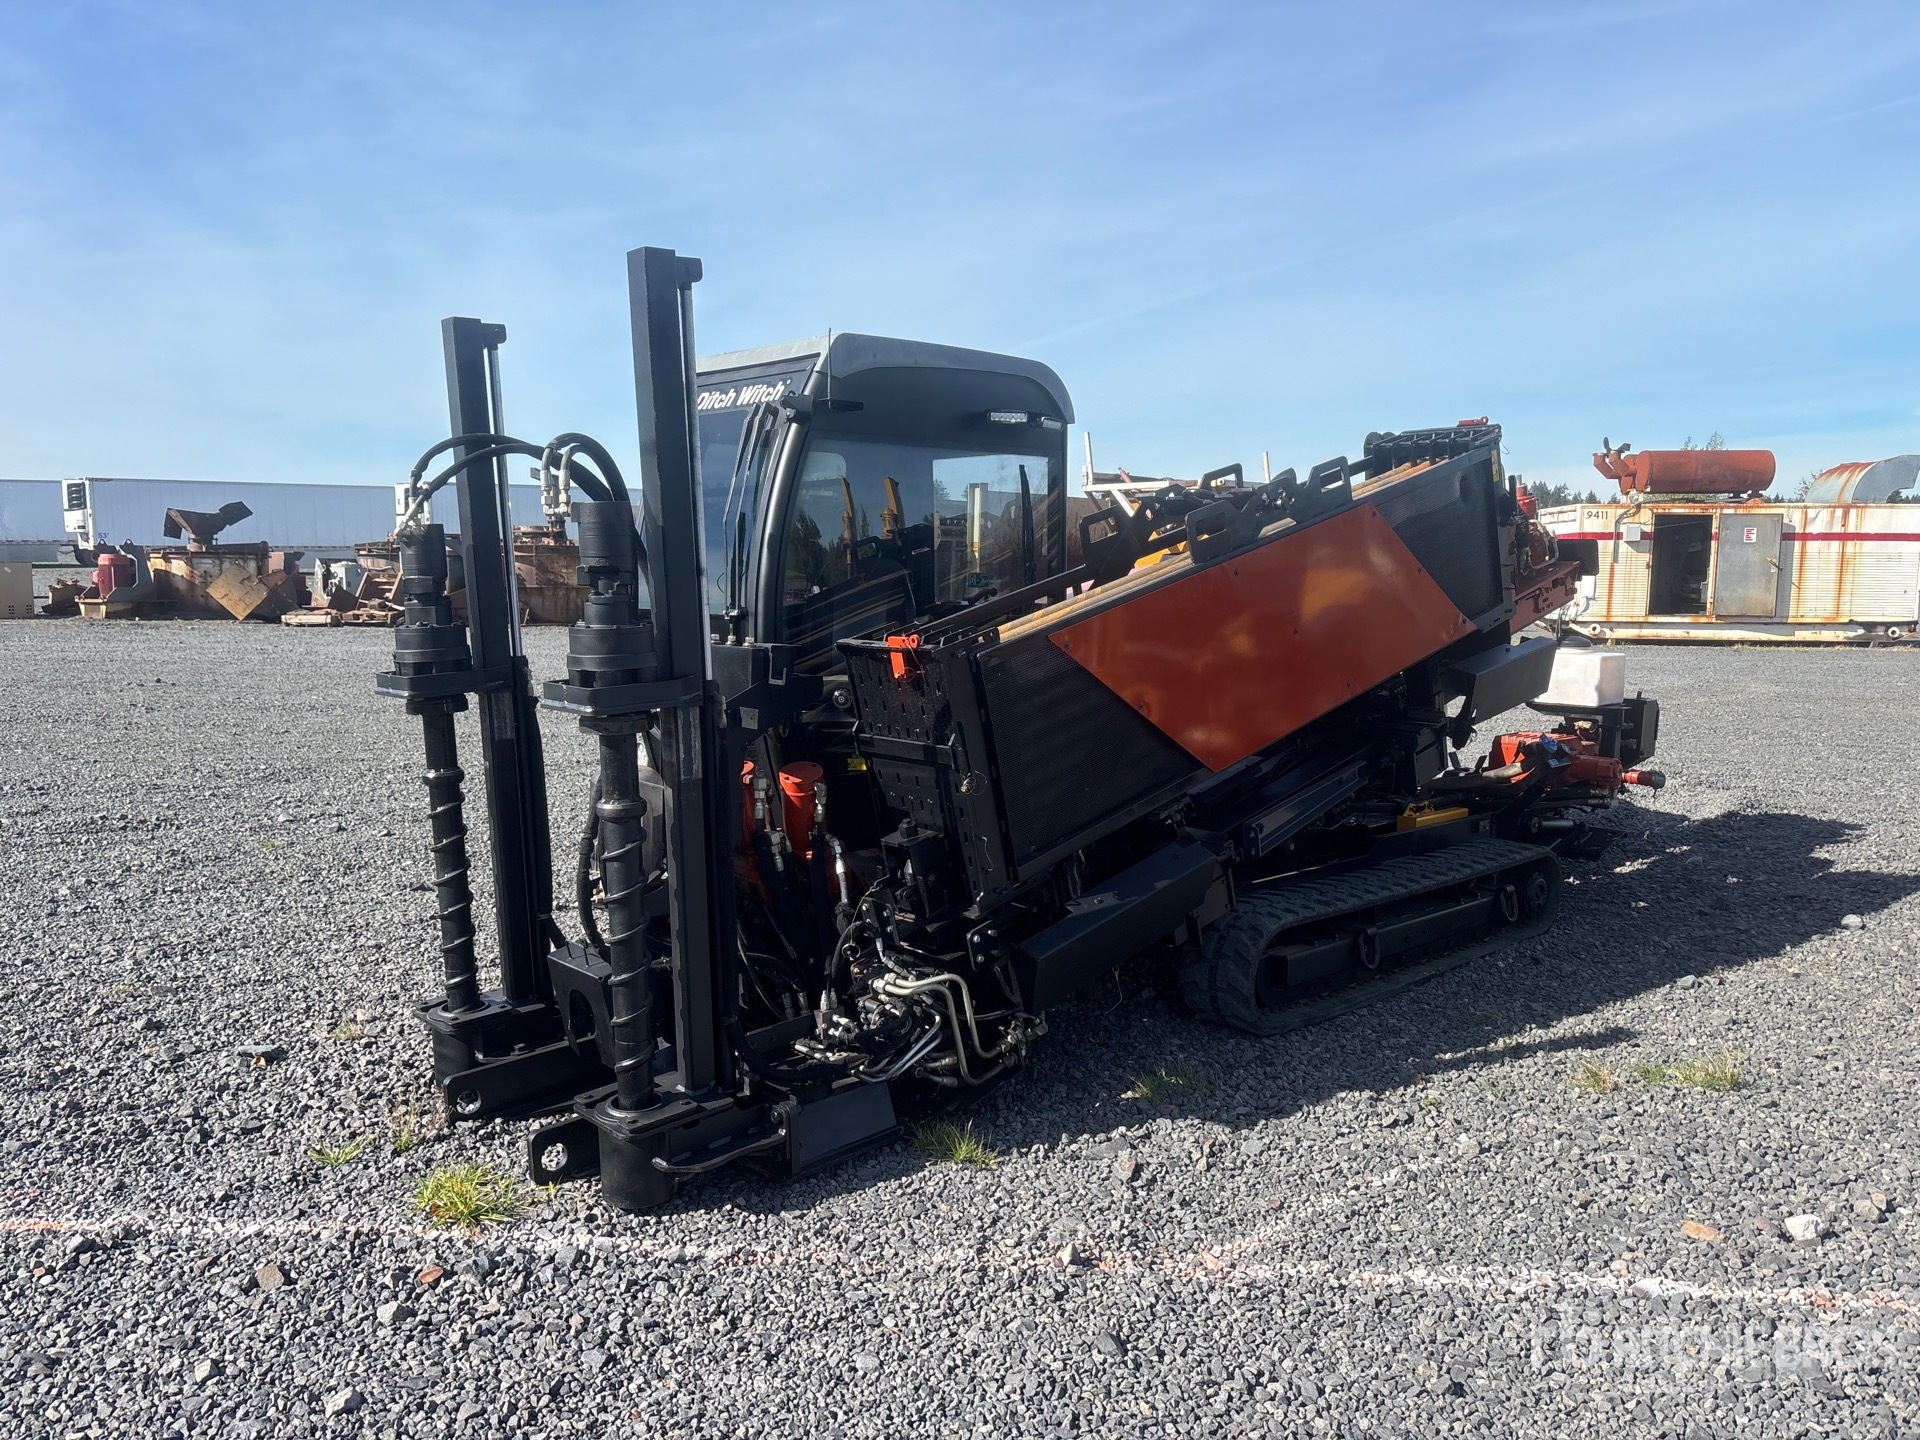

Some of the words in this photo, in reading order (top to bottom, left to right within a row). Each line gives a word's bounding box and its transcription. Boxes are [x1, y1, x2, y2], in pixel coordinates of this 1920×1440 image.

[697, 388, 736, 410] Ditch
[736, 381, 785, 406] Witch
[1586, 510, 1608, 520] 9411
